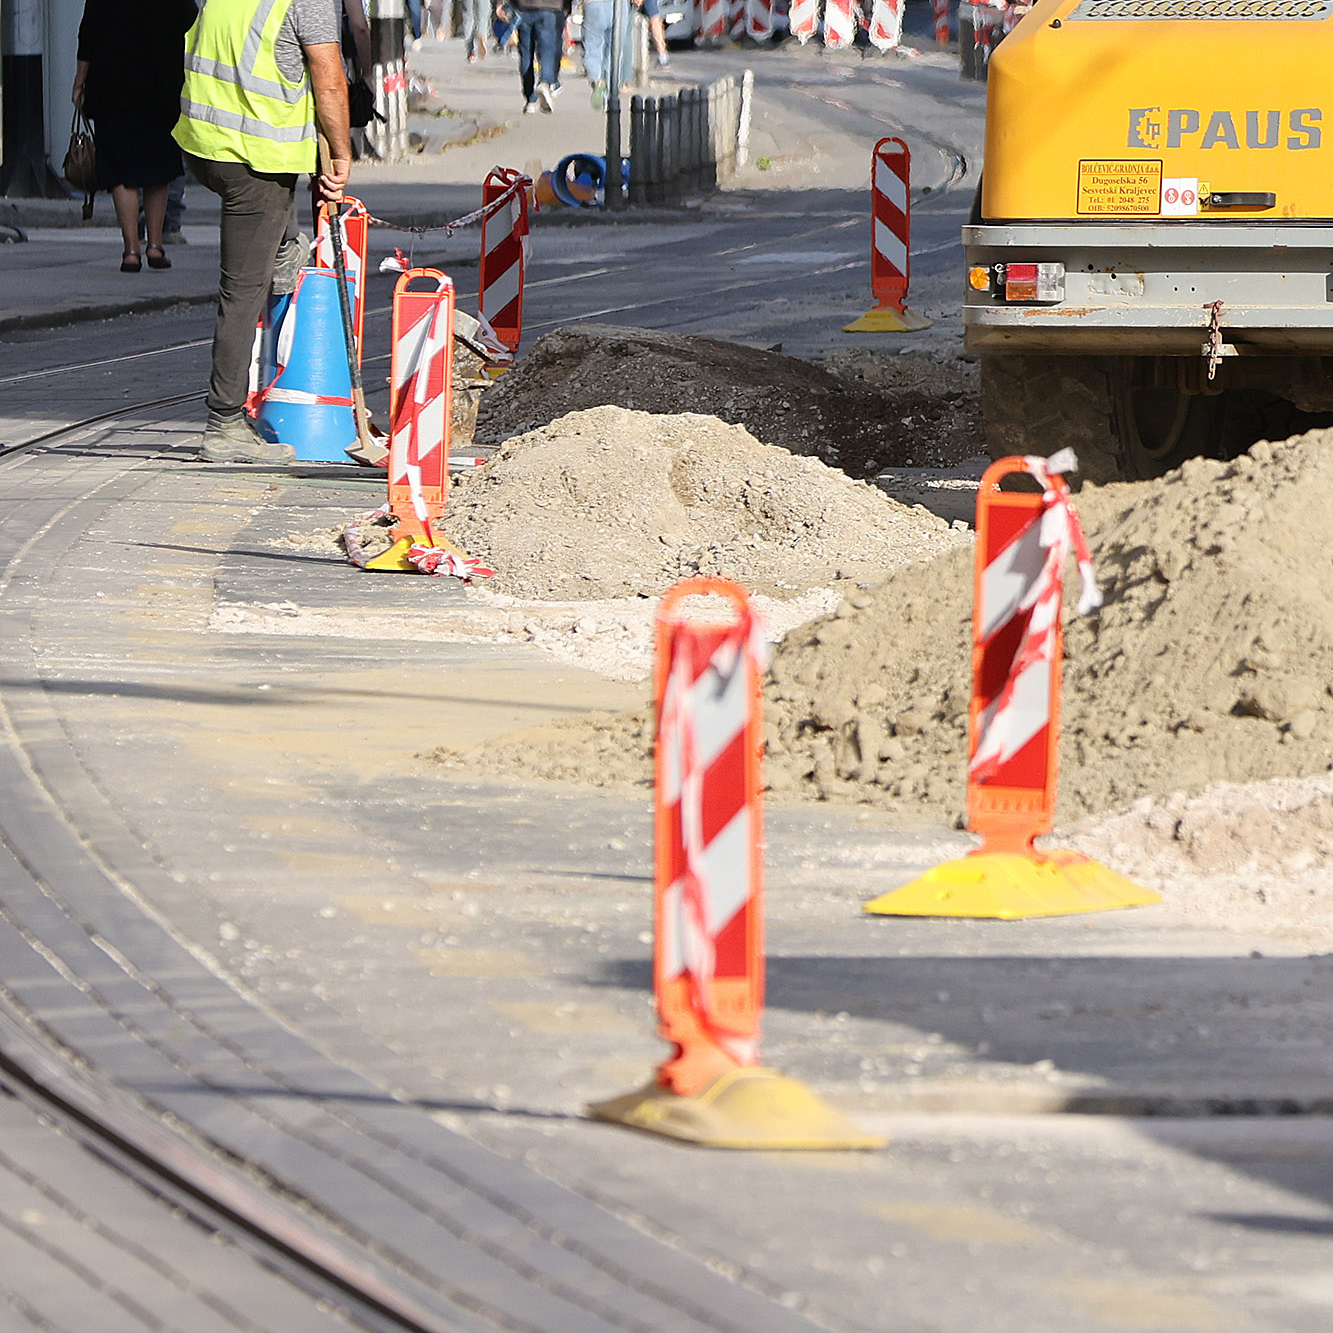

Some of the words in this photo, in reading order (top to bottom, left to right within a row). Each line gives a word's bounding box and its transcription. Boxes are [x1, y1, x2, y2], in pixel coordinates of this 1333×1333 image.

[1166, 108, 1323, 150] PAUS
[1092, 176, 1136, 186] Dugoselska
[1138, 176, 1148, 185] 56
[1082, 186, 1117, 195] Sesvetski
[1119, 186, 1157, 196] Kraljevec
[1106, 196, 1115, 204] 01
[1119, 196, 1135, 204] 2048
[1138, 196, 1150, 204] 275
